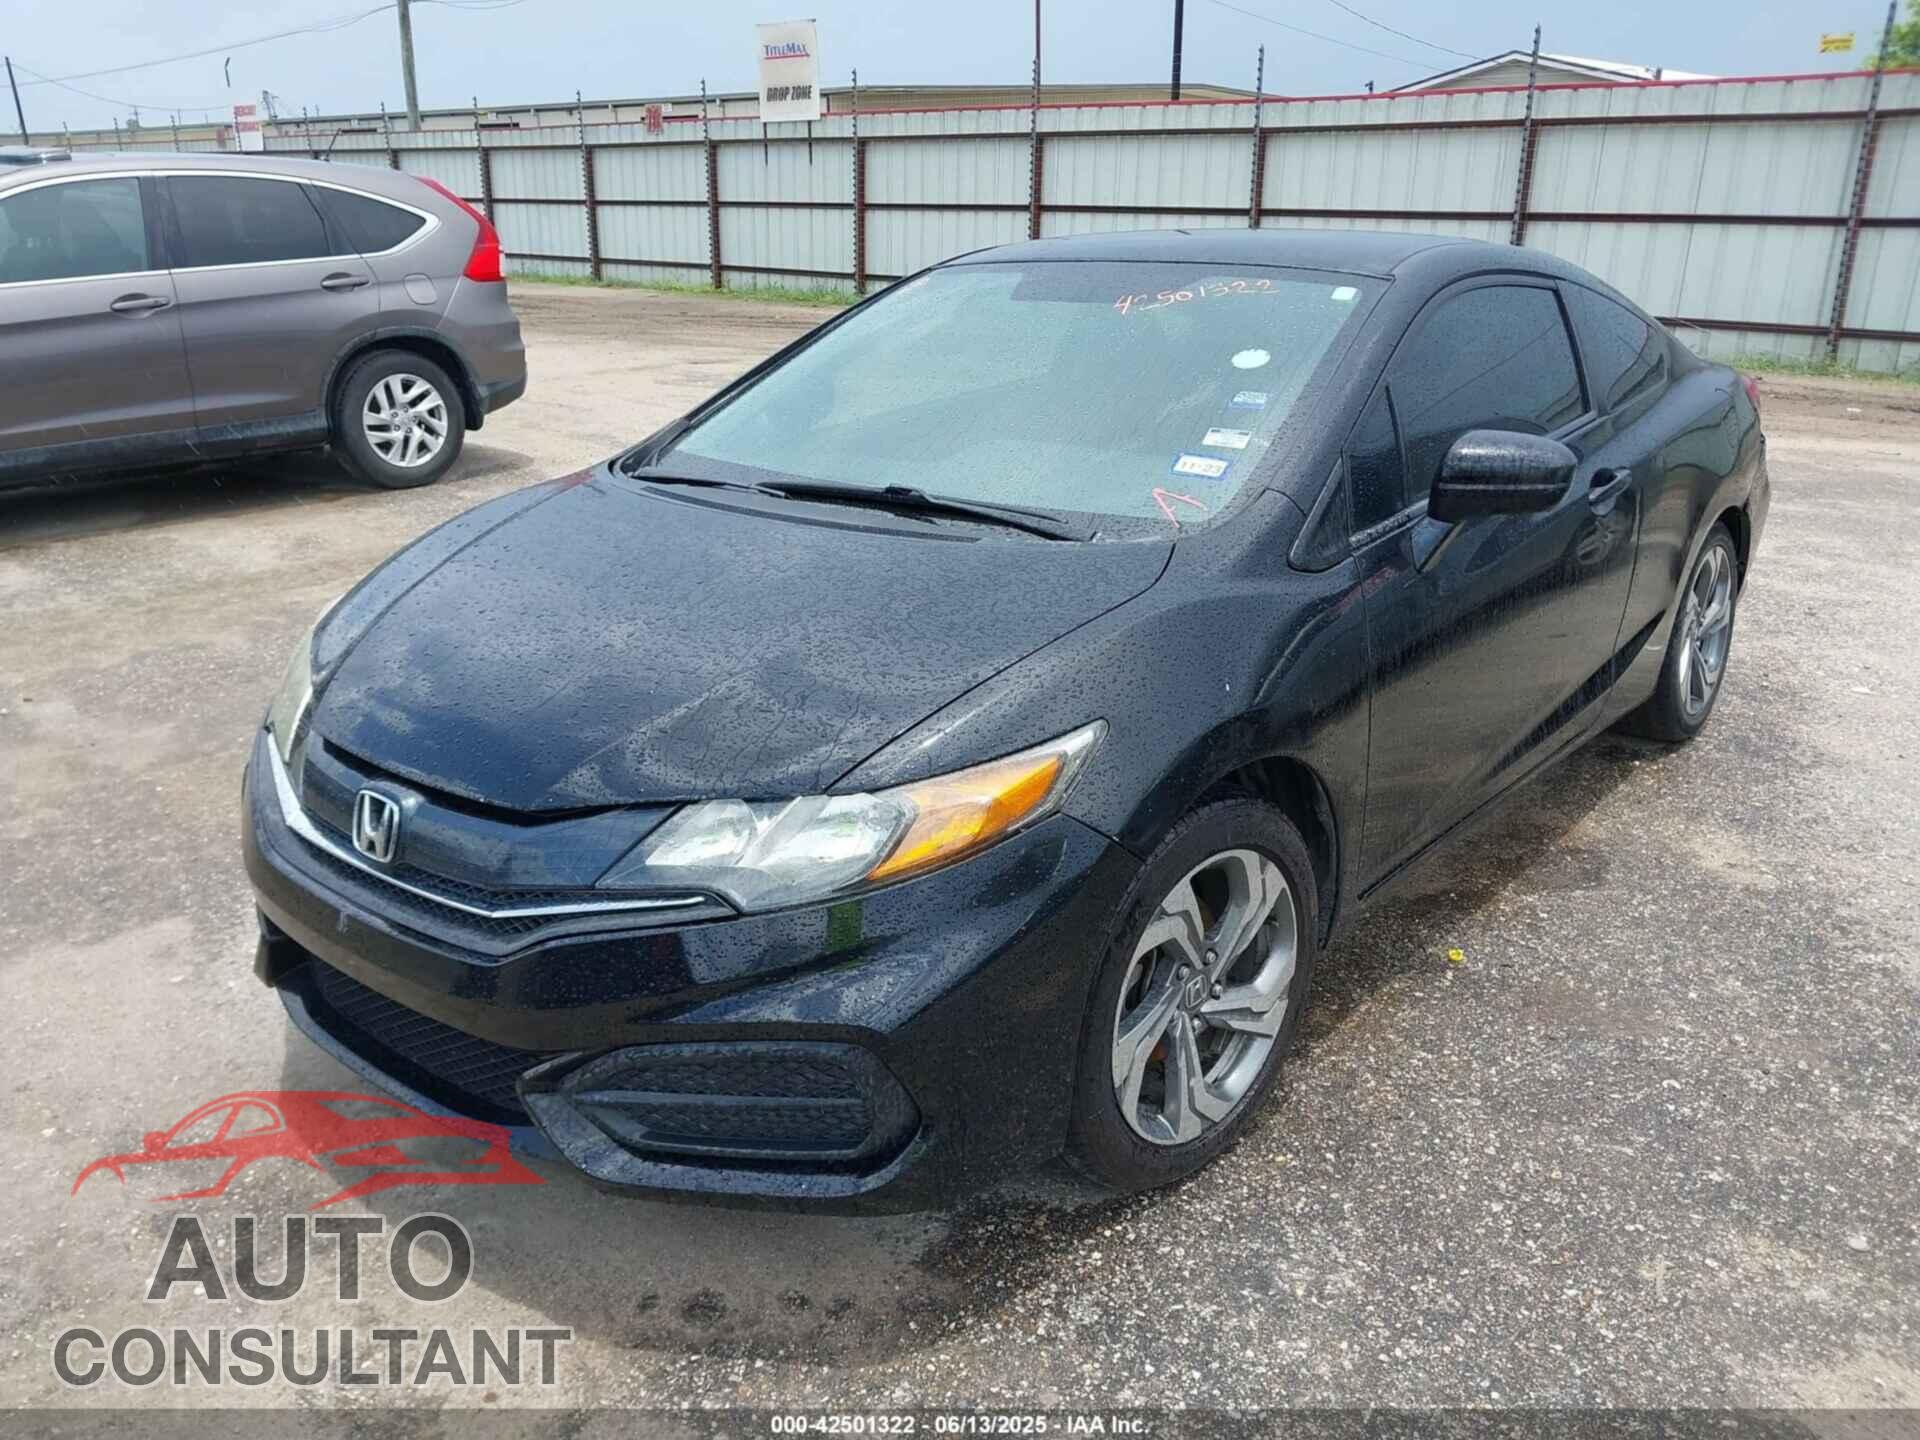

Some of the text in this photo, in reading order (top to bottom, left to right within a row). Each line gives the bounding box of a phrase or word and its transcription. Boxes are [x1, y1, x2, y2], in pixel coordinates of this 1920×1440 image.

[767, 85, 812, 101] DROP ZONE
[1113, 279, 1280, 315] 42501322
